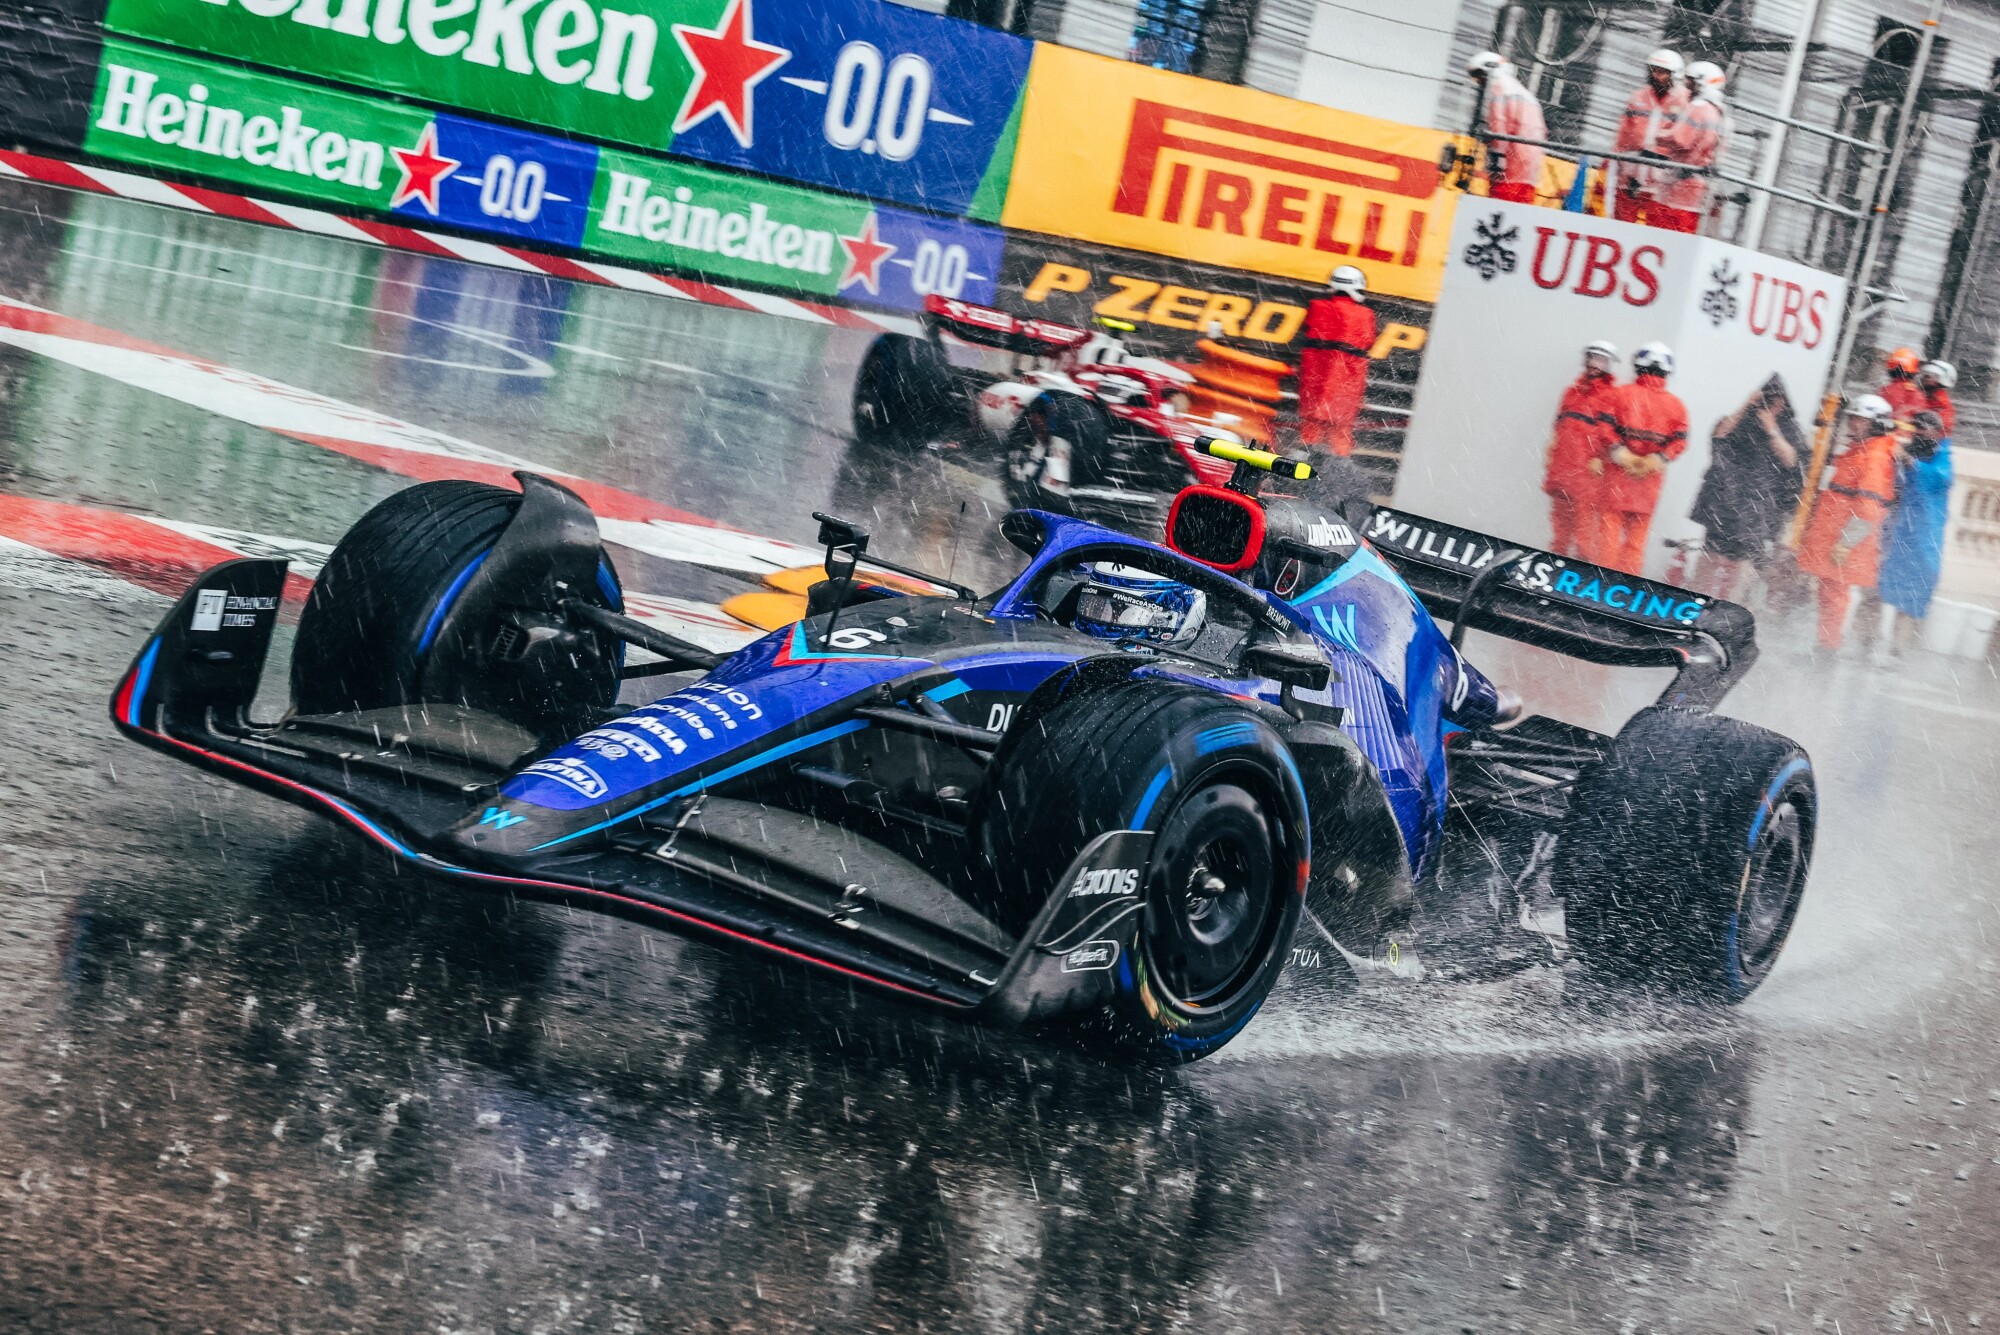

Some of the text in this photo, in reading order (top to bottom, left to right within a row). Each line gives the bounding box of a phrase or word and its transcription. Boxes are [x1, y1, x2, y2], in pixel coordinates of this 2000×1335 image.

[204, 0, 656, 101] eken
[98, 63, 383, 191] Heineken
[1113, 97, 1444, 267] PIRELLI
[601, 170, 833, 275] Heineken
[1531, 226, 1665, 307] UBS
[1025, 261, 1308, 345] P ZERO
[1747, 272, 1828, 350] UBS
[1367, 321, 1427, 361] P
[1307, 516, 1357, 547] LAVAZZA
[1112, 592, 1164, 612] #WeRaceAsOne
[1265, 605, 1291, 631] BREMONT
[1554, 568, 1704, 622] RACING
[818, 627, 888, 650] 6
[576, 728, 662, 763] ELLI
[600, 716, 688, 755] AZZA
